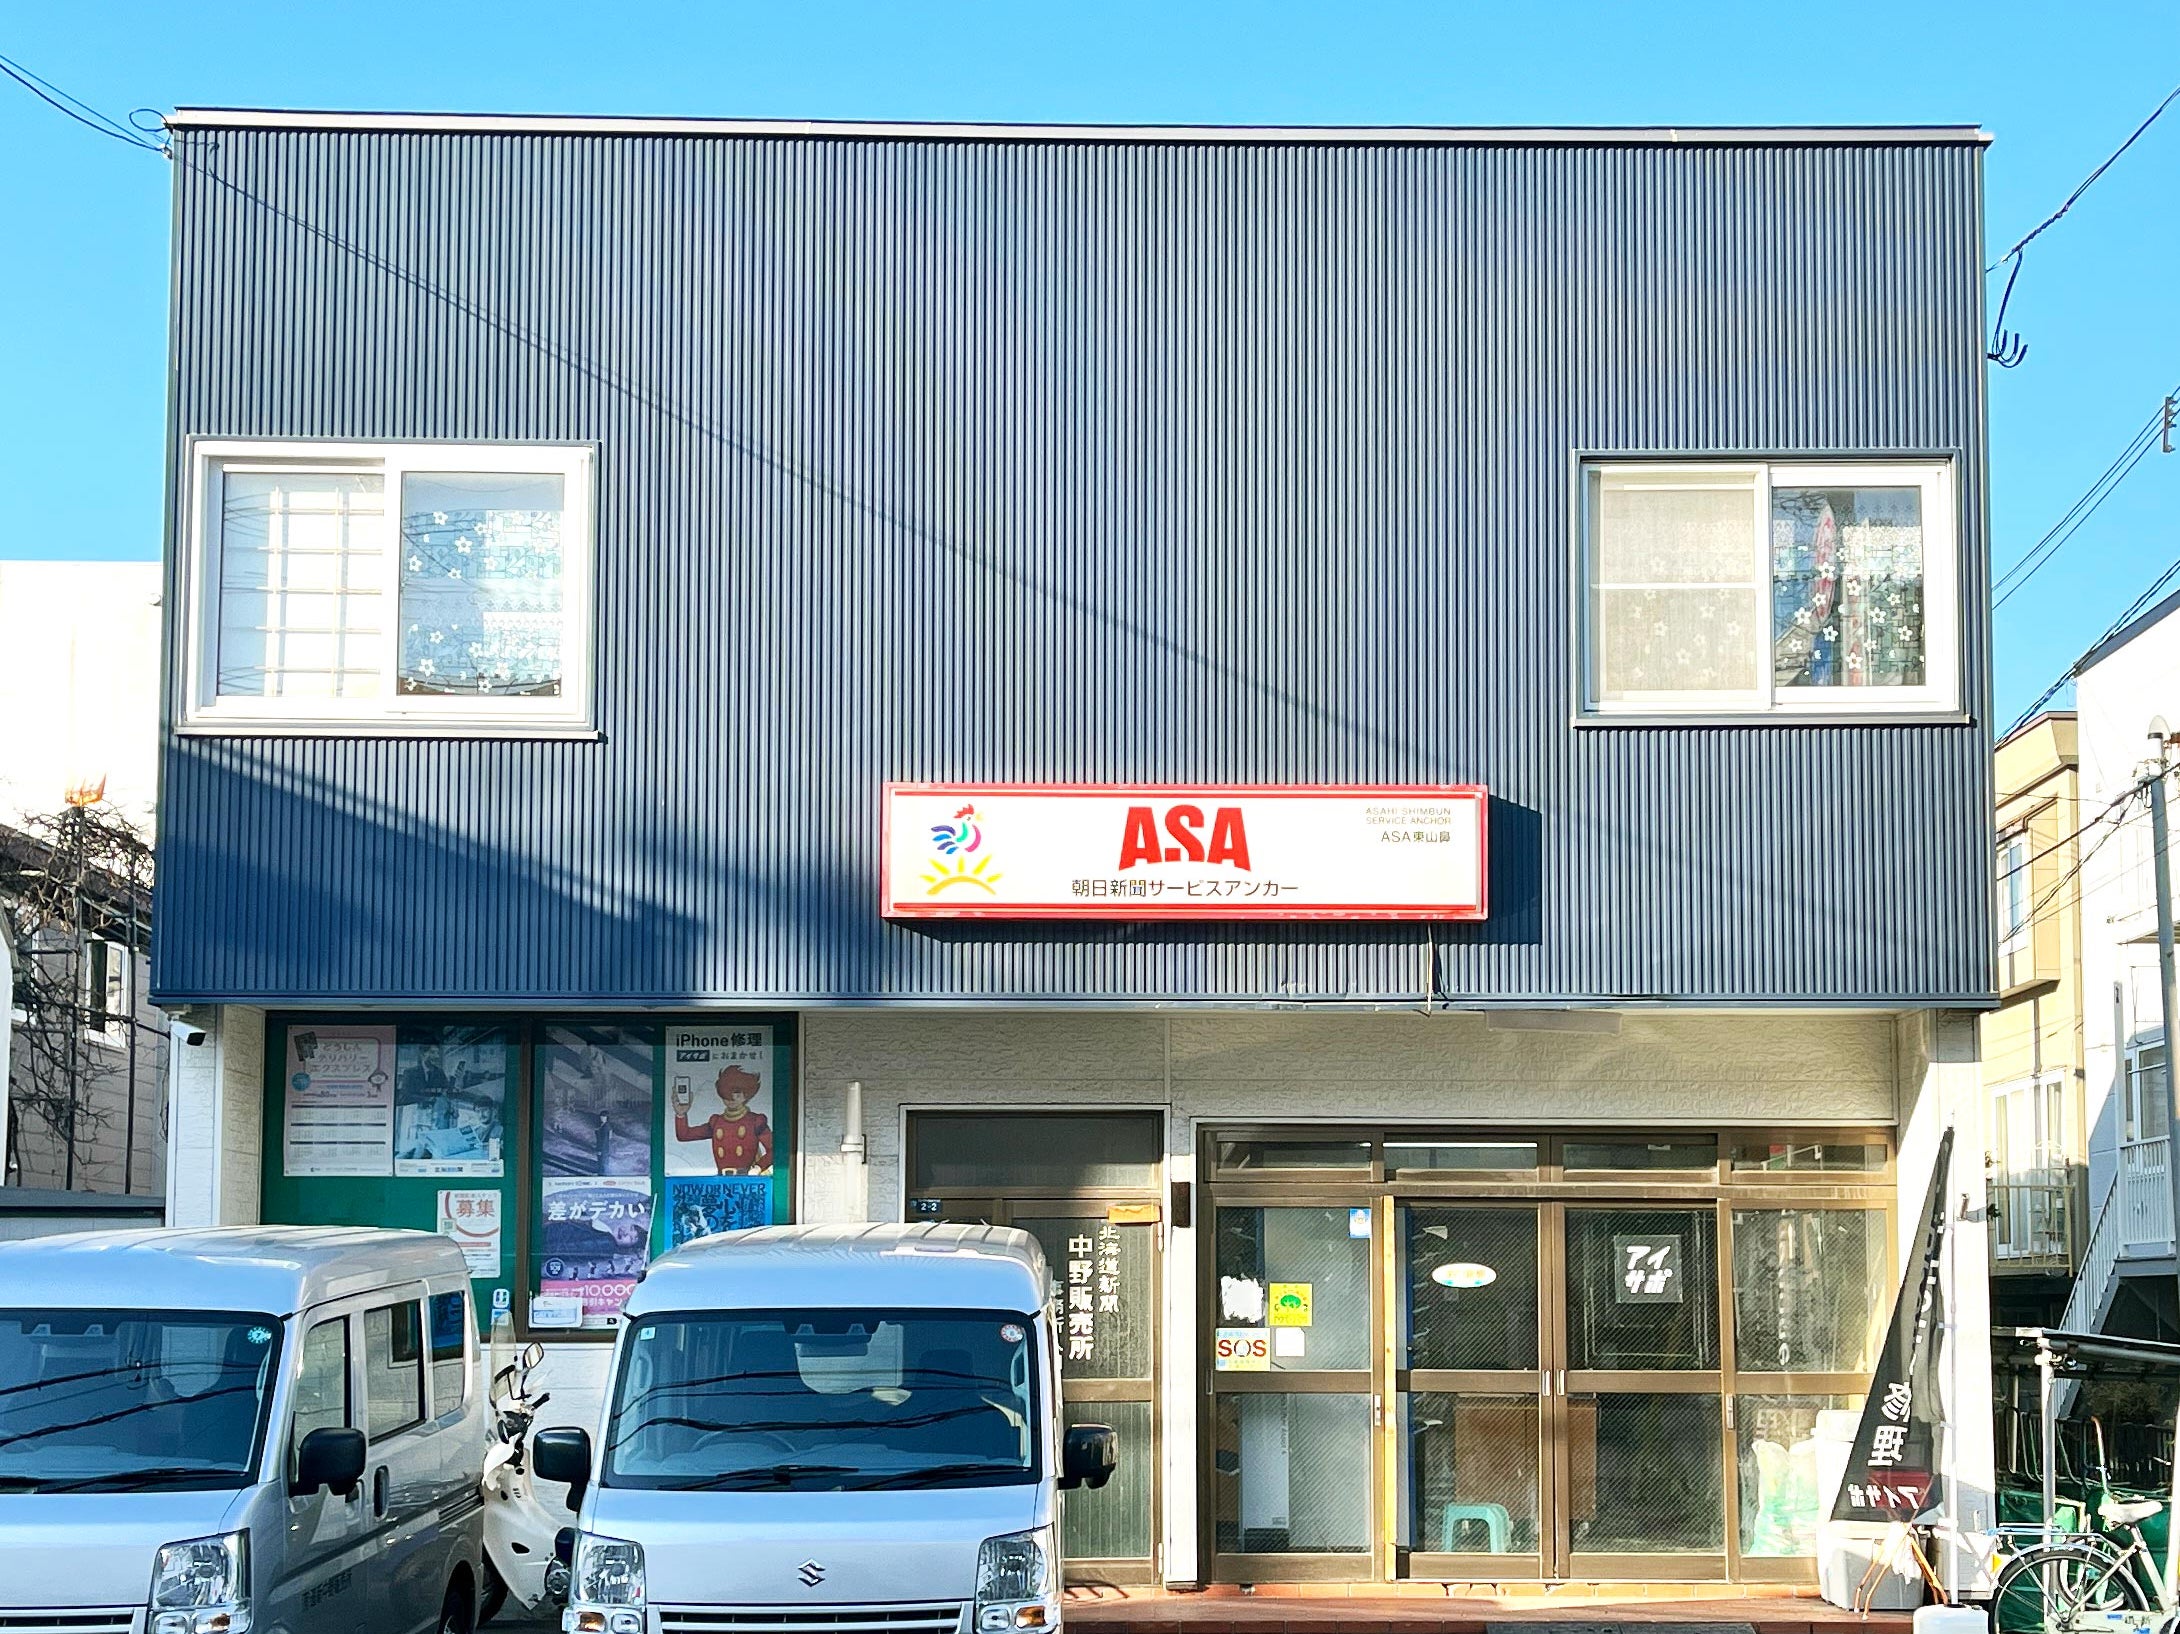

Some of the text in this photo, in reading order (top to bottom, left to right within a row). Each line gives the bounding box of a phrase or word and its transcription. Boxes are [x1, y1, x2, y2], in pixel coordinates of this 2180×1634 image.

[1366, 807, 1451, 816] ASAHI SHIMBUN
[1366, 816, 1452, 825] SERVICE ANCHOR
[1118, 805, 1251, 872] ASA
[1071, 879, 1299, 898] 朝日新聞サービスアンカー
[673, 1183, 765, 1195] NOW OR NEVER
[455, 1199, 495, 1218] 募集
[547, 1200, 646, 1221] 差がデカい
[1068, 1234, 1094, 1361] 中野販売所
[1217, 1339, 1267, 1358] SOS
